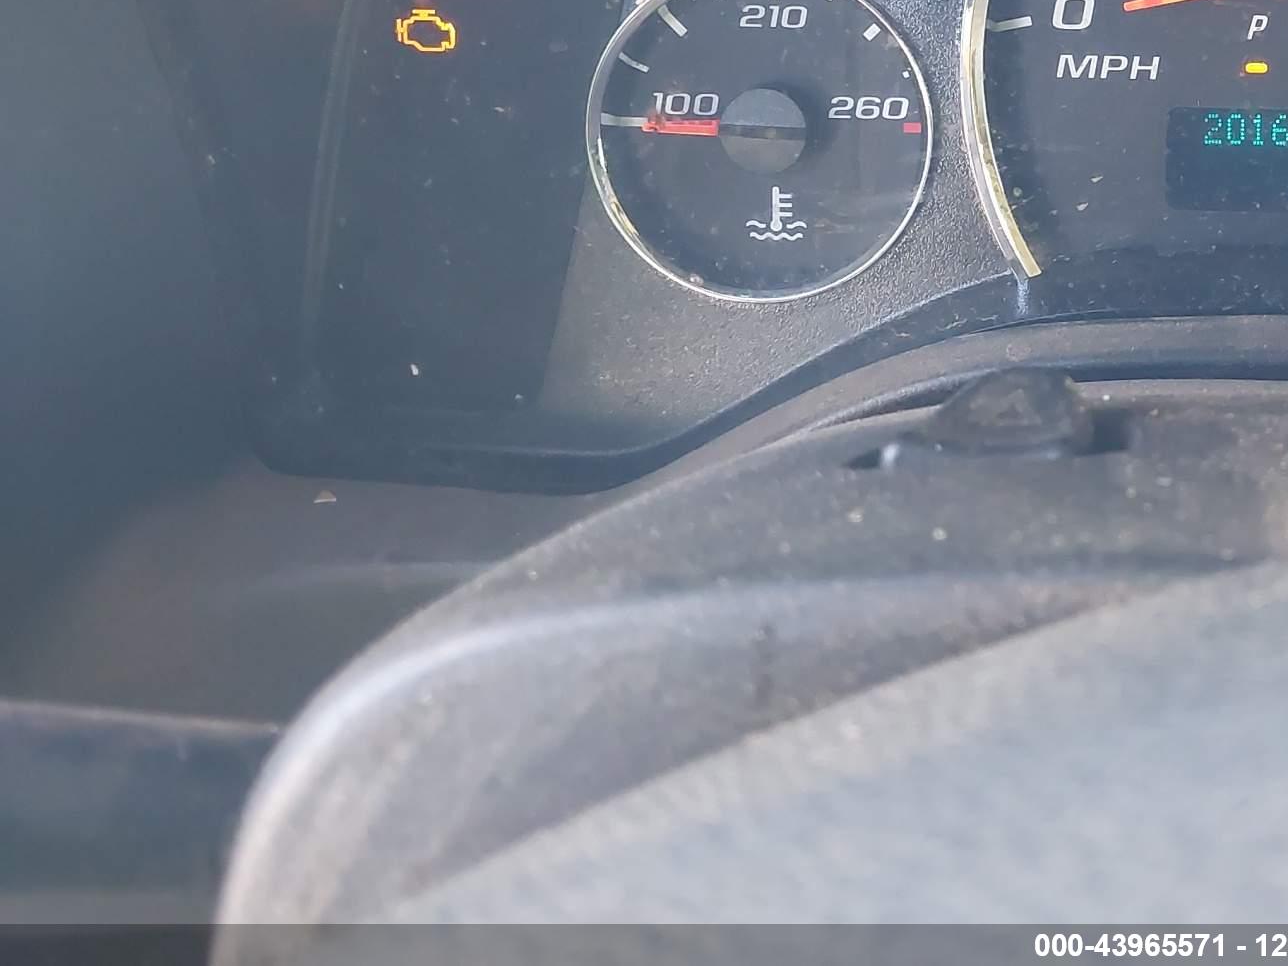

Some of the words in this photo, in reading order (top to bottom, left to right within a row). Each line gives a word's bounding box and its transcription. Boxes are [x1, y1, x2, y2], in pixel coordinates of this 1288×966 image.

[739, 4, 808, 29] 210
[1056, 54, 1161, 80] MPH
[653, 91, 720, 116] 100
[827, 96, 910, 120] 260
